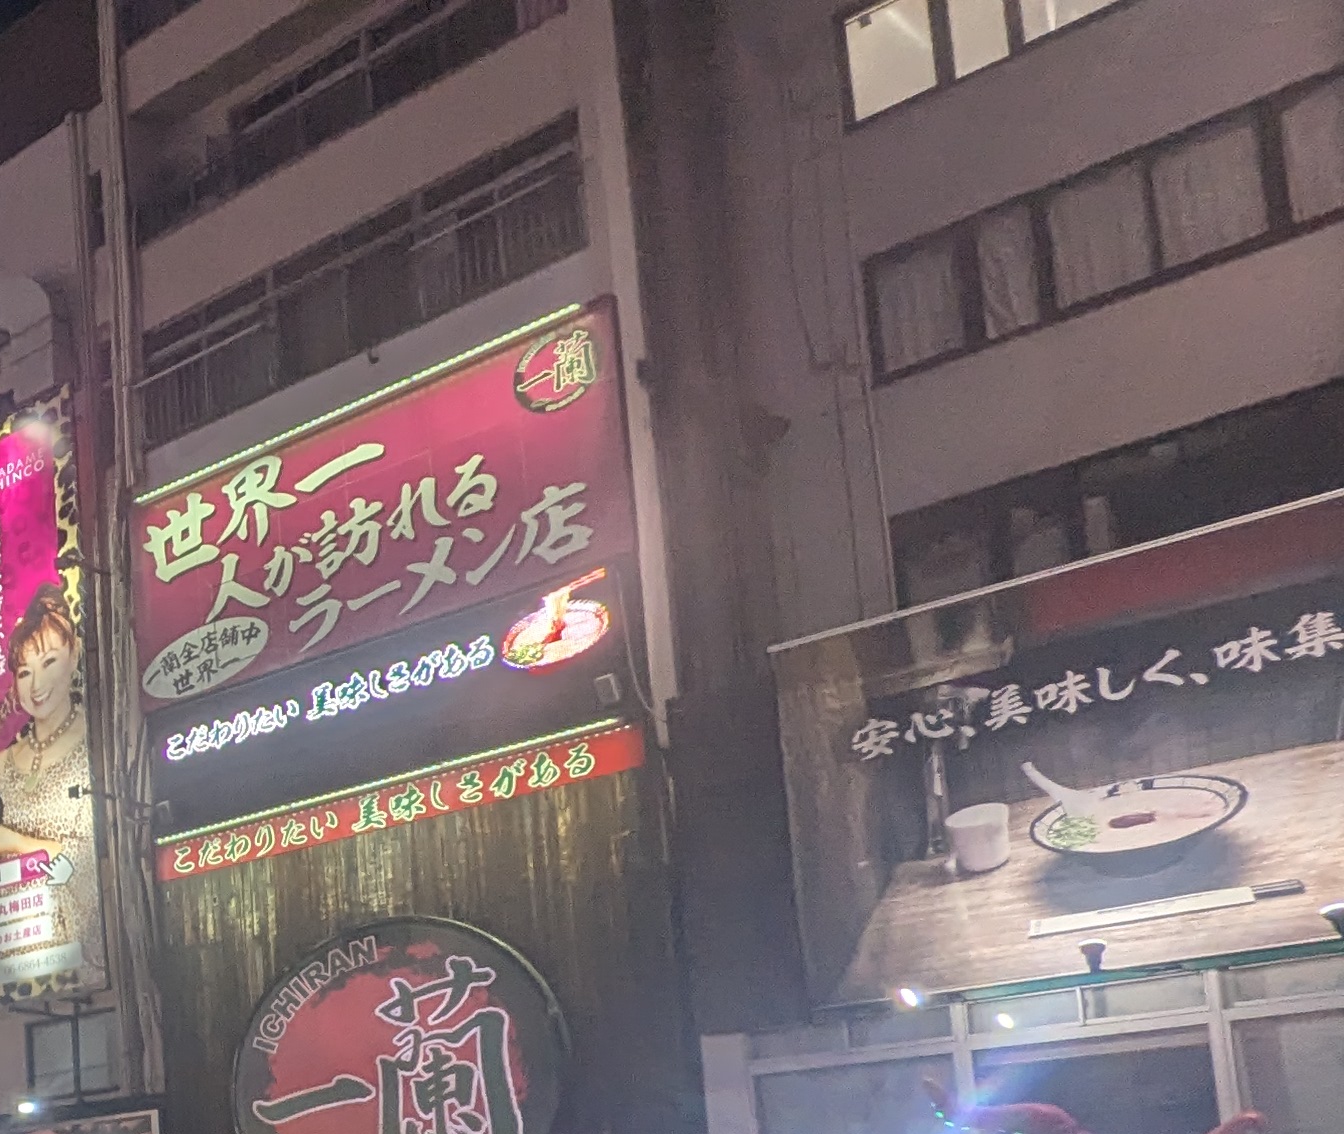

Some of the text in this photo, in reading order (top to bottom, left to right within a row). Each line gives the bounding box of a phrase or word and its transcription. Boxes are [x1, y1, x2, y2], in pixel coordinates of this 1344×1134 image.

[517, 329, 596, 393] 一蘭
[143, 443, 385, 584] 世界一
[206, 454, 499, 624] 人が訪れる
[289, 482, 596, 655] ラーメン店
[166, 634, 496, 762] こだわりたい 美味しさがある
[173, 652, 257, 697] 世界一
[172, 743, 597, 874] こだわりたい 美味しさがある
[252, 935, 379, 1055] ICHIRAN
